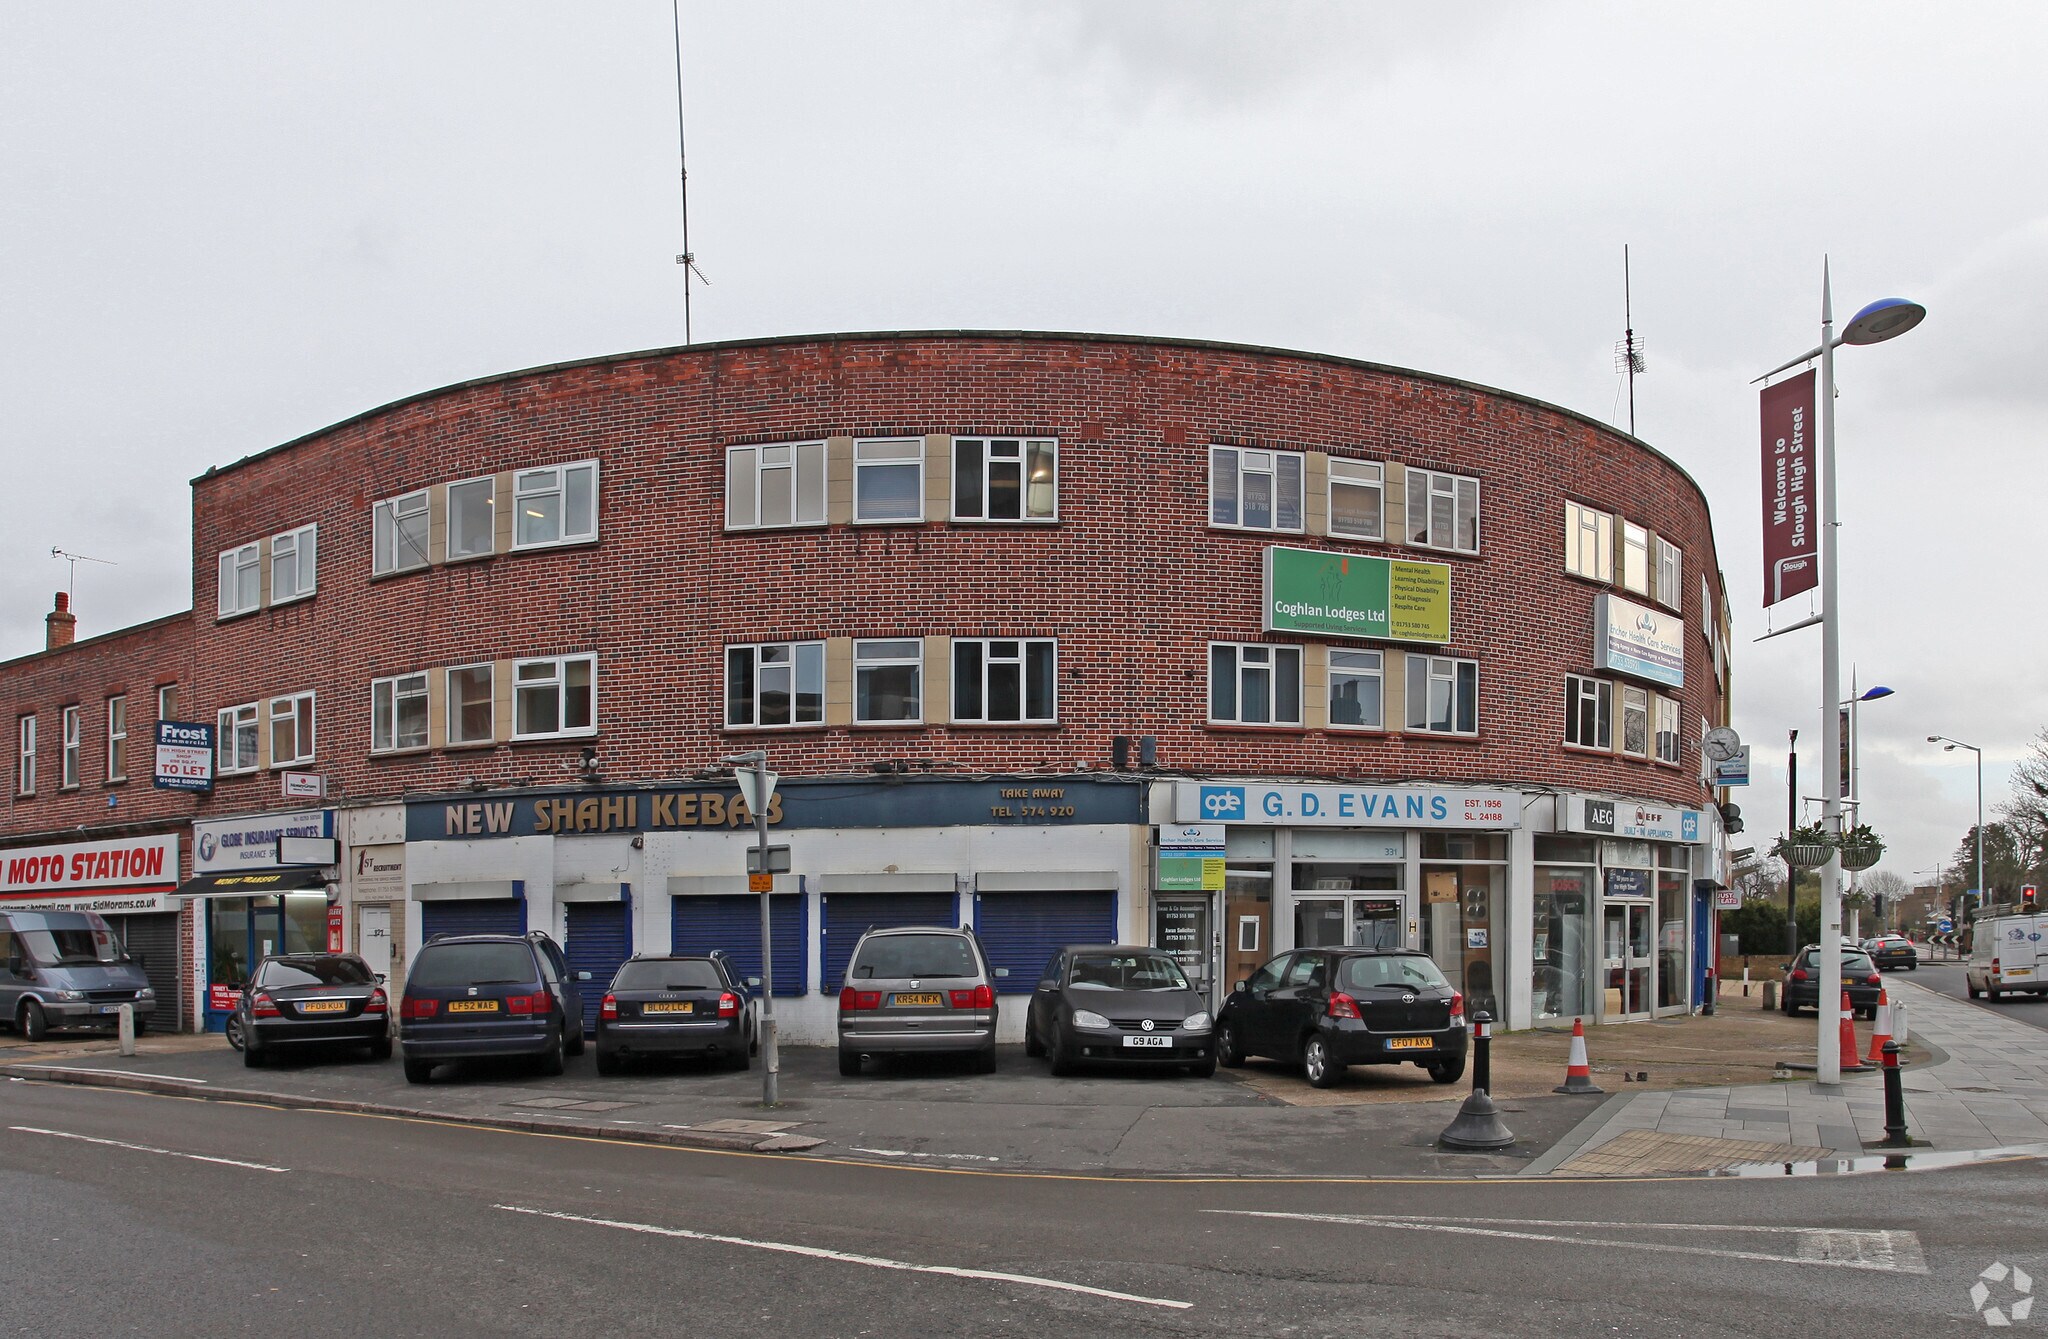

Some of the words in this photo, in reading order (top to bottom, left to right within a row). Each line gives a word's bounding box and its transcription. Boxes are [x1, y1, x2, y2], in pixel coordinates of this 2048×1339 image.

[1790, 406, 1804, 452] Street
[1774, 437, 1786, 455] to
[1790, 456, 1807, 491] High
[1774, 457, 1787, 526] Welcome
[1791, 494, 1808, 547] Slough
[1395, 565, 1414, 573] Mental
[1414, 567, 1431, 575] Health
[1782, 561, 1807, 570] Slough
[1394, 575, 1417, 584] Learning
[1417, 577, 1445, 586] Disabilities
[1416, 586, 1440, 595] Disability
[1407, 595, 1432, 603] Diagnosis
[1275, 600, 1323, 617] Coghlan
[1325, 605, 1365, 622] Lodges
[1367, 609, 1385, 622] Ltd
[1394, 603, 1414, 611] Respite
[1294, 620, 1325, 630] Supported
[1325, 622, 1343, 631] Living
[1343, 624, 1367, 633] Services
[1610, 623, 1628, 638] Enchor
[1628, 630, 1646, 645] Health
[1647, 636, 1660, 649] Care
[1660, 640, 1681, 655] Services
[161, 724, 208, 740] Frost
[161, 764, 179, 774] TO
[183, 766, 206, 776] LET
[1000, 788, 1029, 798] TAKE
[1032, 788, 1065, 798] AWAY
[1338, 793, 1448, 820] EVANS
[1464, 799, 1482, 807] EST.
[1484, 800, 1502, 808] 1956
[446, 802, 515, 836] NEW
[533, 795, 637, 833] SHAHI
[652, 793, 784, 828] KEBAB
[991, 806, 1016, 816] TEL.
[1021, 806, 1045, 816] 574
[1050, 806, 1074, 816] 920
[1464, 812, 1477, 821] SL.
[1480, 813, 1503, 821] 24188
[1592, 808, 1613, 825] AEG
[1647, 828, 1673, 838] APPLIANCES
[221, 832, 243, 848] GLOBE
[240, 850, 267, 860] INSURANCE
[1384, 848, 1398, 856] 331
[7, 854, 65, 885] MOTO
[70, 846, 164, 881] STATION
[373, 863, 402, 872] RECRUITMENT
[214, 877, 242, 885] MONEY
[241, 875, 281, 883] TRANSFER
[74, 898, 157, 911] www.SidMorams.co.uk
[896, 995, 919, 1004] KR54
[921, 994, 938, 1004] NFK
[305, 1002, 327, 1010] PF08
[328, 1001, 344, 1010] KUX
[452, 1001, 475, 1010] LF52
[477, 1001, 494, 1009] WAE
[648, 1003, 669, 1012] BL02
[672, 1002, 689, 1011] LCF
[1133, 1037, 1145, 1045] G9
[1147, 1037, 1163, 1046] AGA
[1391, 1038, 1413, 1047] EF07
[1415, 1037, 1431, 1046] AKX
